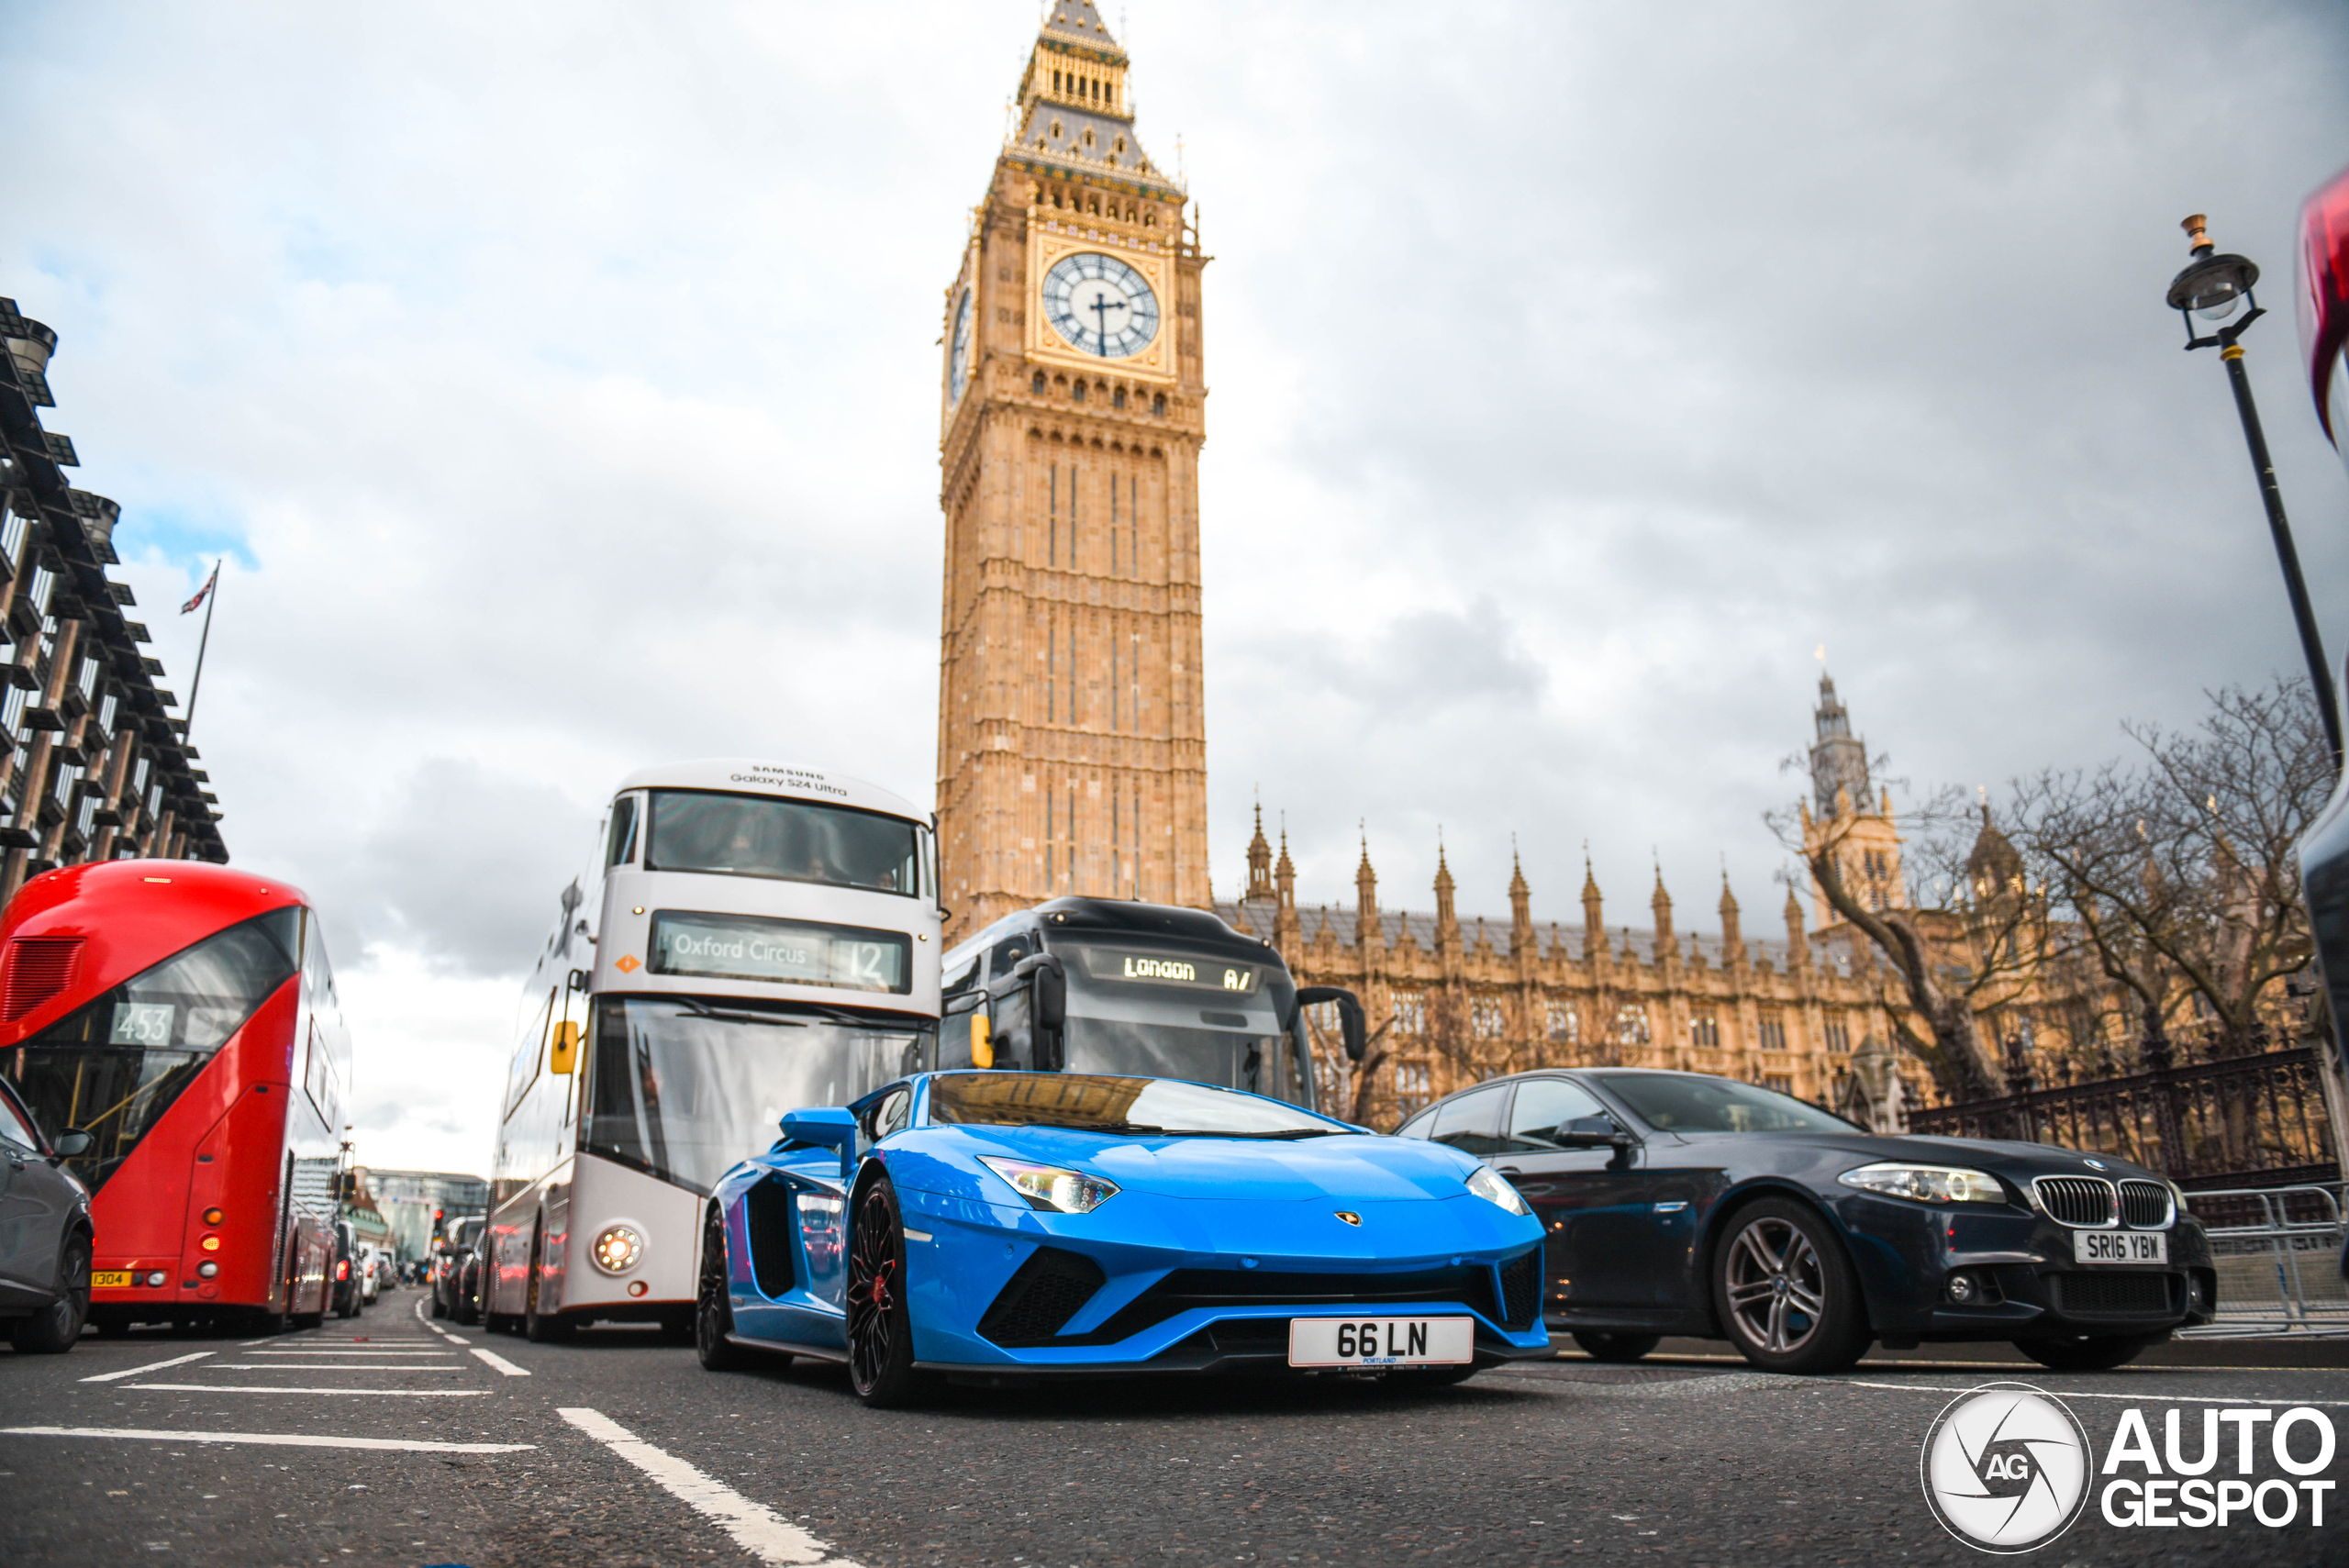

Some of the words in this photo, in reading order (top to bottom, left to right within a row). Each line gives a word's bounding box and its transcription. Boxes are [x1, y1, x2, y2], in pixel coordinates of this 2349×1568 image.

[730, 773, 784, 787] Galaxy
[787, 779, 811, 789] S24
[815, 783, 847, 796] Ultra
[752, 765, 824, 780] SAMSUNG
[674, 934, 742, 959] Oxford
[750, 940, 807, 963] Circus
[851, 942, 883, 978] 12
[117, 1008, 168, 1040] 453
[2087, 1234, 2126, 1258] SR16
[2130, 1235, 2158, 1259] YBW
[94, 1273, 122, 1285] 1304
[1338, 1323, 1377, 1358] 66
[1387, 1322, 1427, 1356] LN
